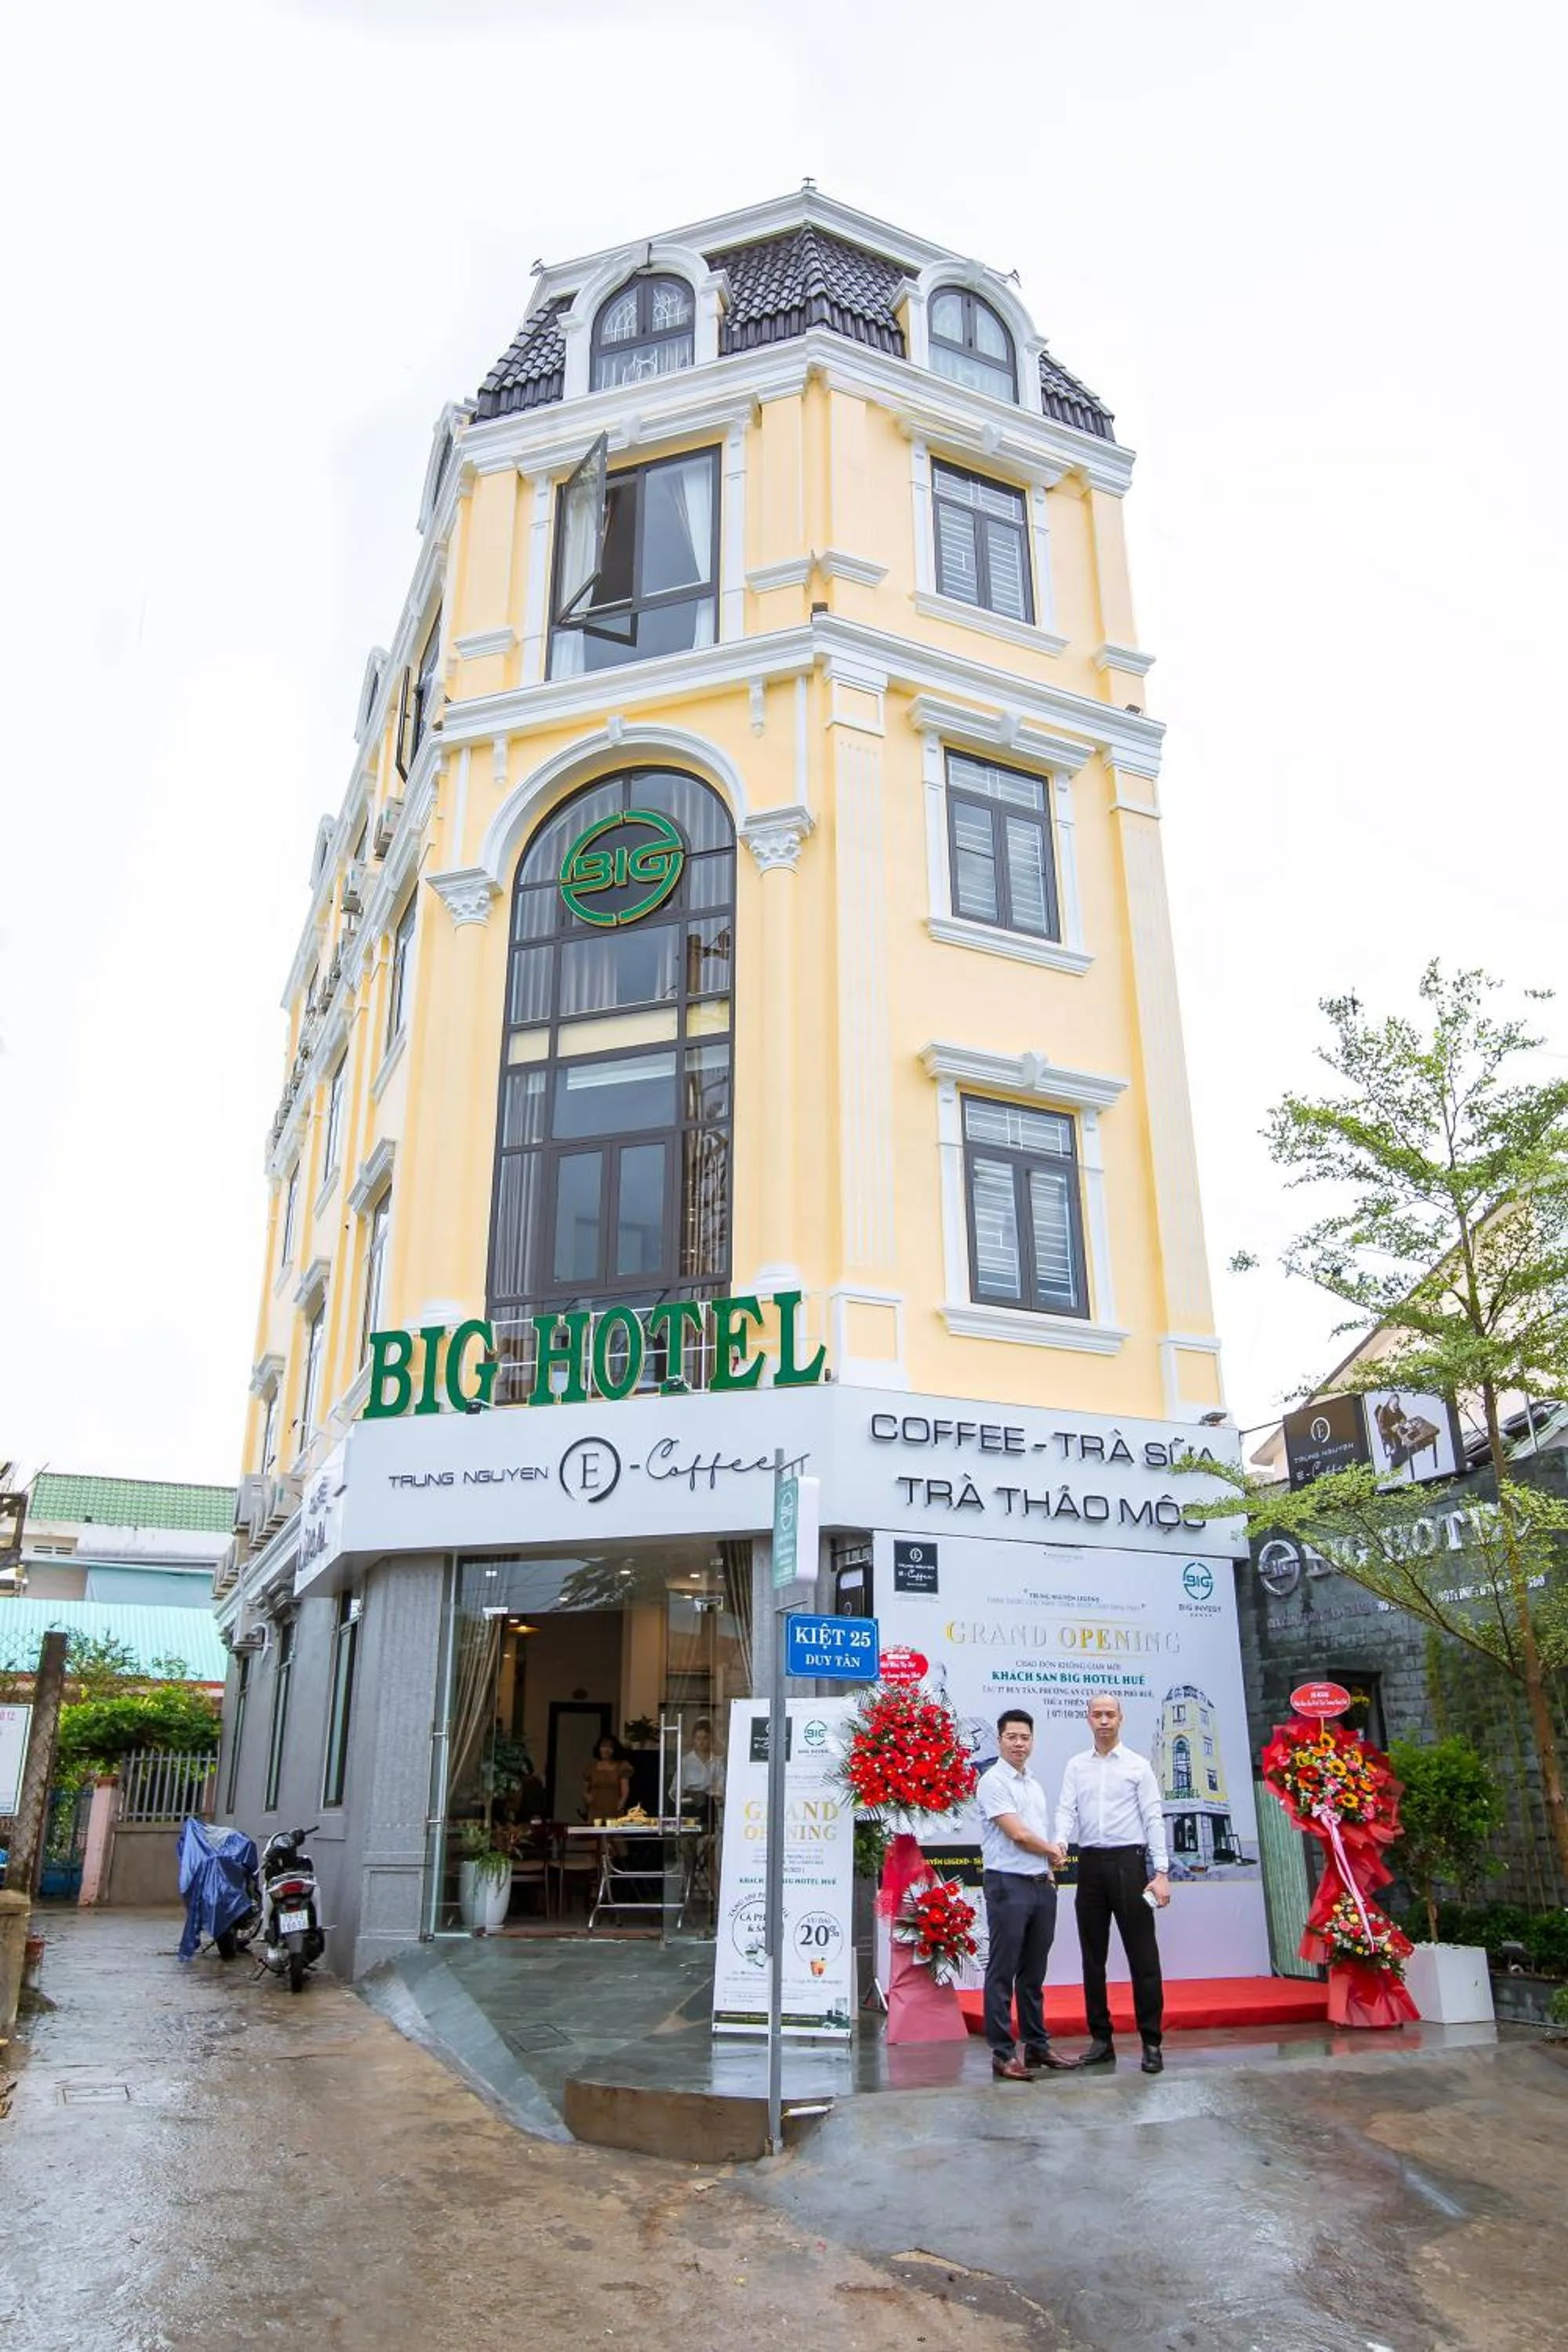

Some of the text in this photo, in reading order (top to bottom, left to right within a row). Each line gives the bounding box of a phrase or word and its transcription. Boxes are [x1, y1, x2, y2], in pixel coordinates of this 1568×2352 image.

[363, 1290, 827, 1418] BIG HOTEL
[871, 1413, 1026, 1454] COFFEE
[1054, 1428, 1134, 1465] TRÀ
[388, 1472, 454, 1488] TRUNG
[463, 1467, 549, 1484] NGUYEN
[897, 1472, 985, 1512] TRÀ
[995, 1484, 1109, 1521] THẢO
[796, 1622, 872, 1650] KIỆT 25
[946, 1619, 1181, 1654] GRAND OPENING
[805, 1653, 861, 1668] DUY TÂN
[1060, 1672, 1080, 1684] BIG
[1083, 1674, 1120, 1685] HOTEL
